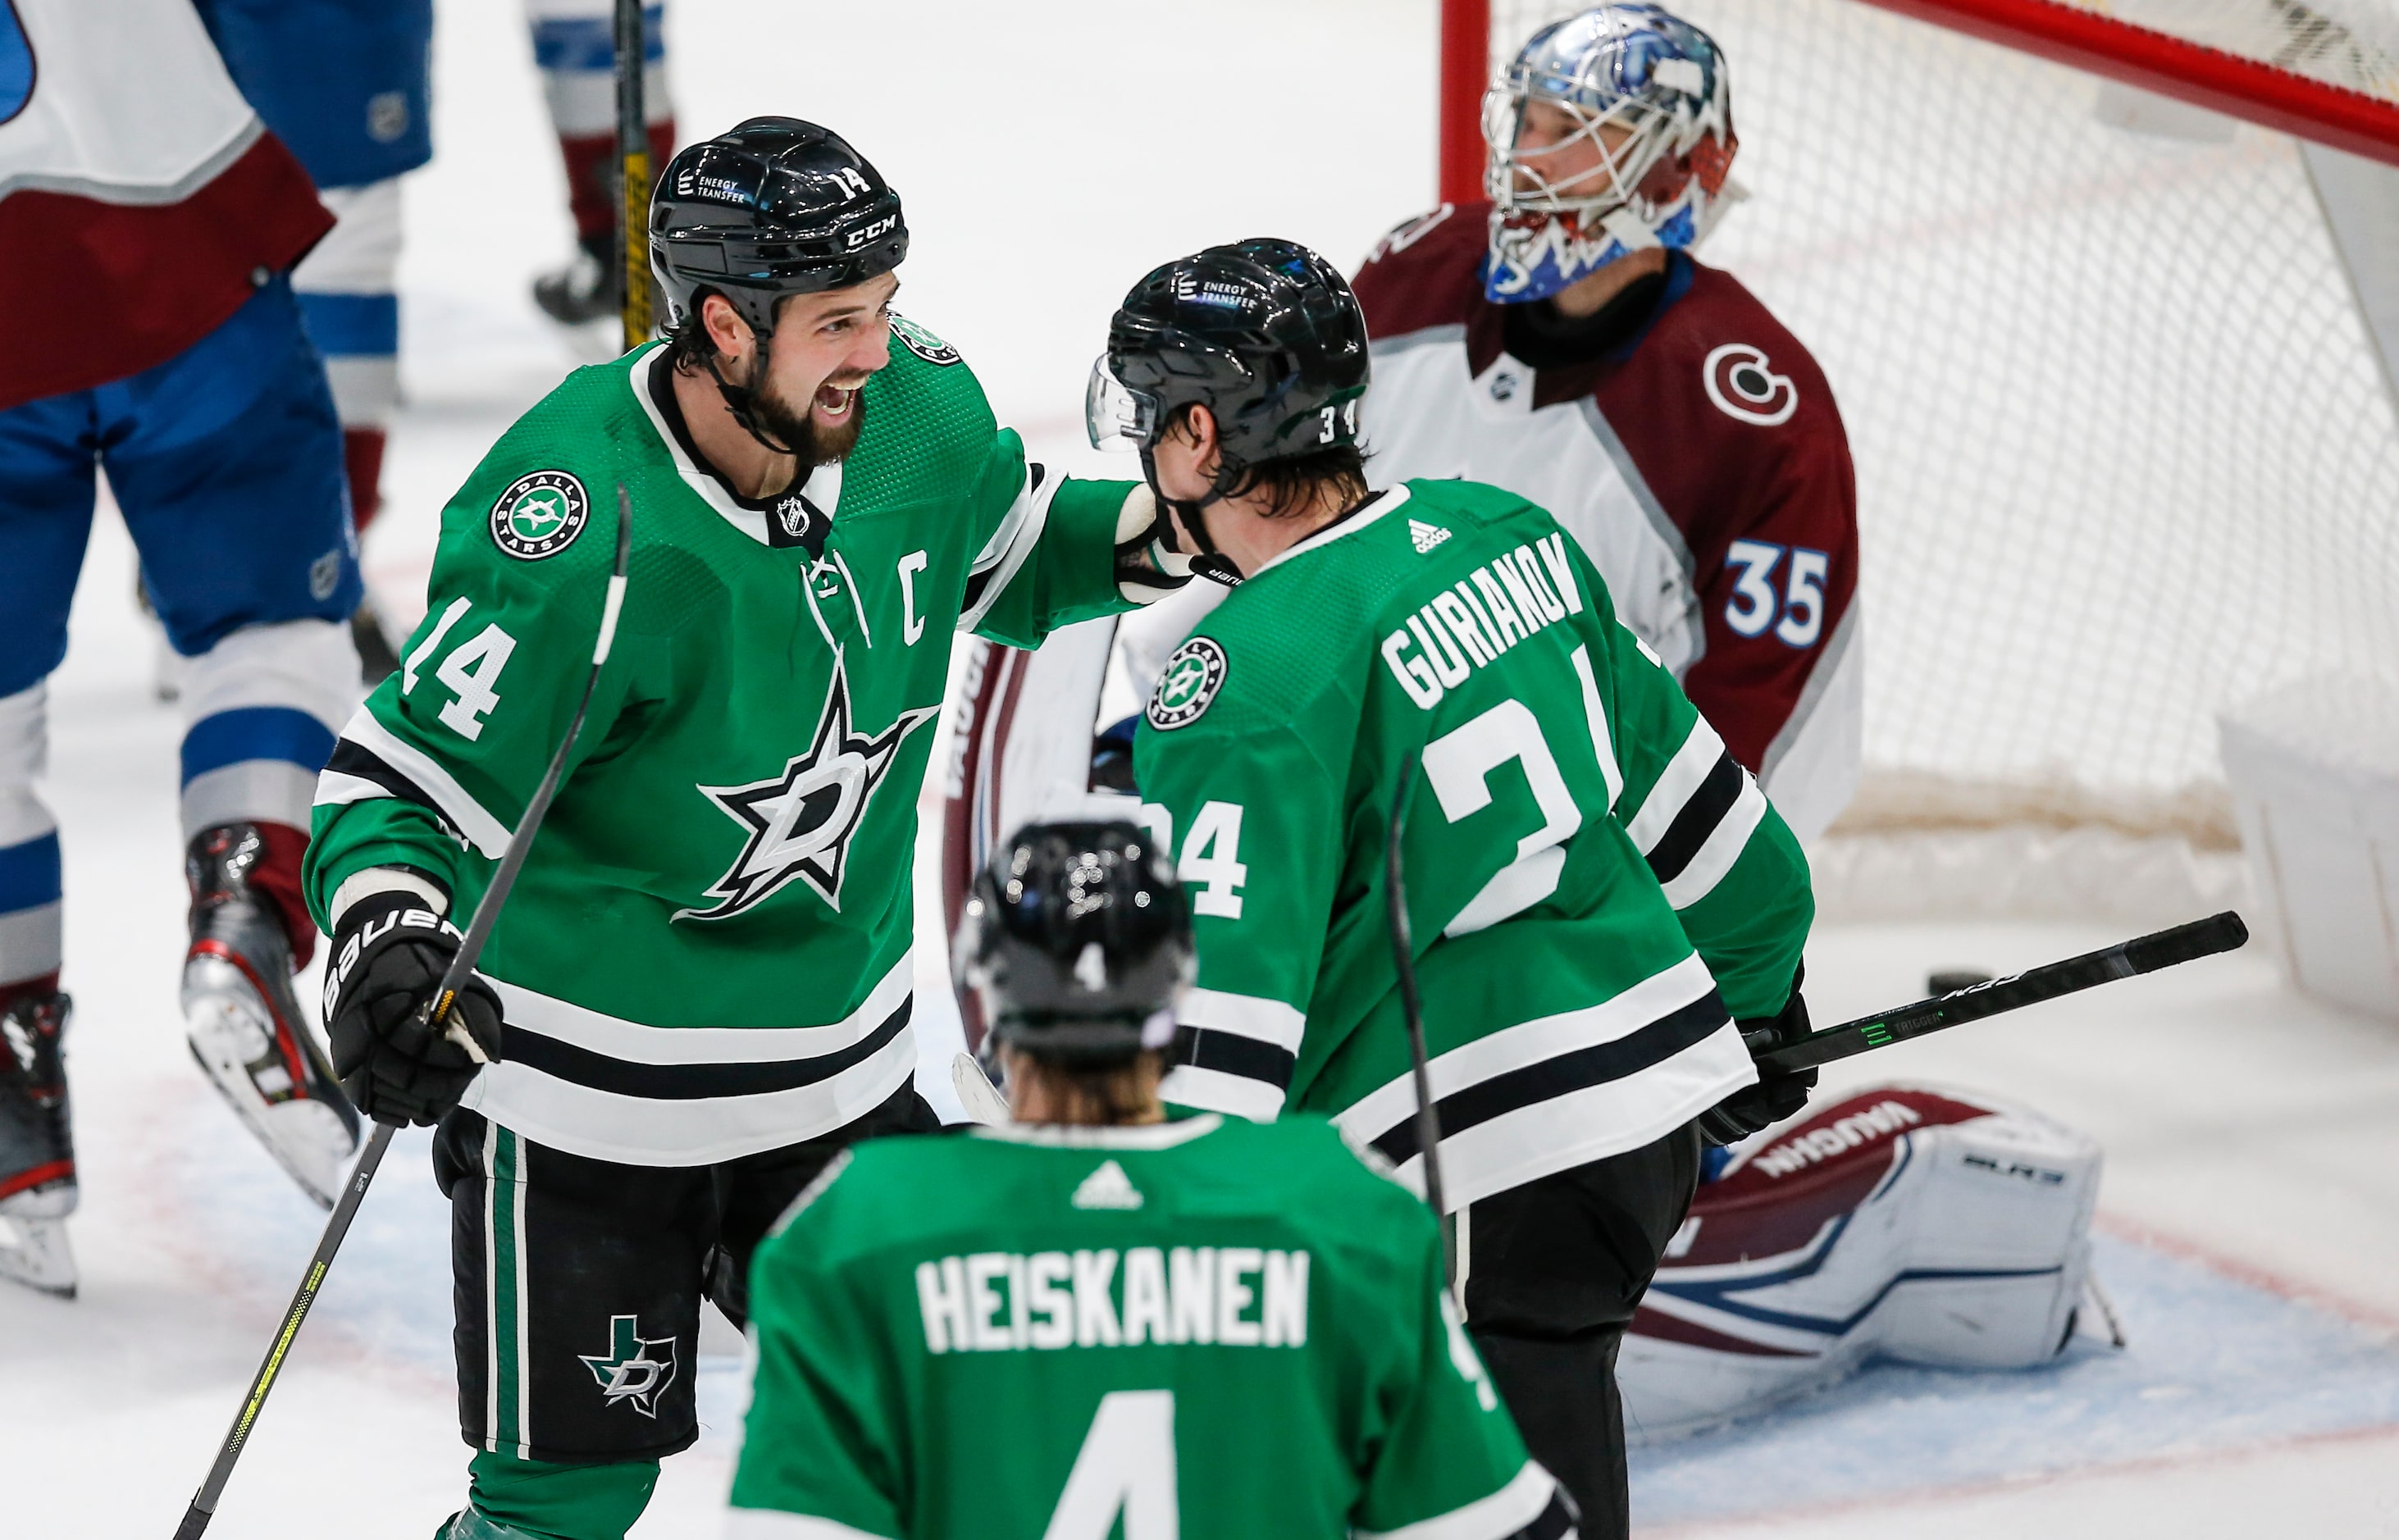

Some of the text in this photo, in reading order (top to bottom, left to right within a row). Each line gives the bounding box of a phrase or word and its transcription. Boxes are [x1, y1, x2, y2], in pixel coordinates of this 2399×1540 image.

[697, 187, 745, 203] TRANSFER
[699, 176, 738, 191] ENERGY
[827, 166, 871, 200] 14
[847, 214, 896, 247] CCM
[1202, 292, 1257, 309] TRANSFER
[1203, 281, 1247, 295] ENERGY
[1319, 399, 1357, 444] 34
[516, 476, 581, 526] DALLAS
[496, 509, 554, 554] STARS
[1415, 527, 1453, 554] adidas
[897, 549, 928, 647] C
[1724, 538, 1829, 649] 35
[1380, 531, 1584, 711] GURIANOV
[402, 595, 518, 742] 14
[1074, 941, 1106, 992] 4
[1752, 1100, 1922, 1178] VAUGHN
[914, 1246, 1311, 1355] HEISKANEN
